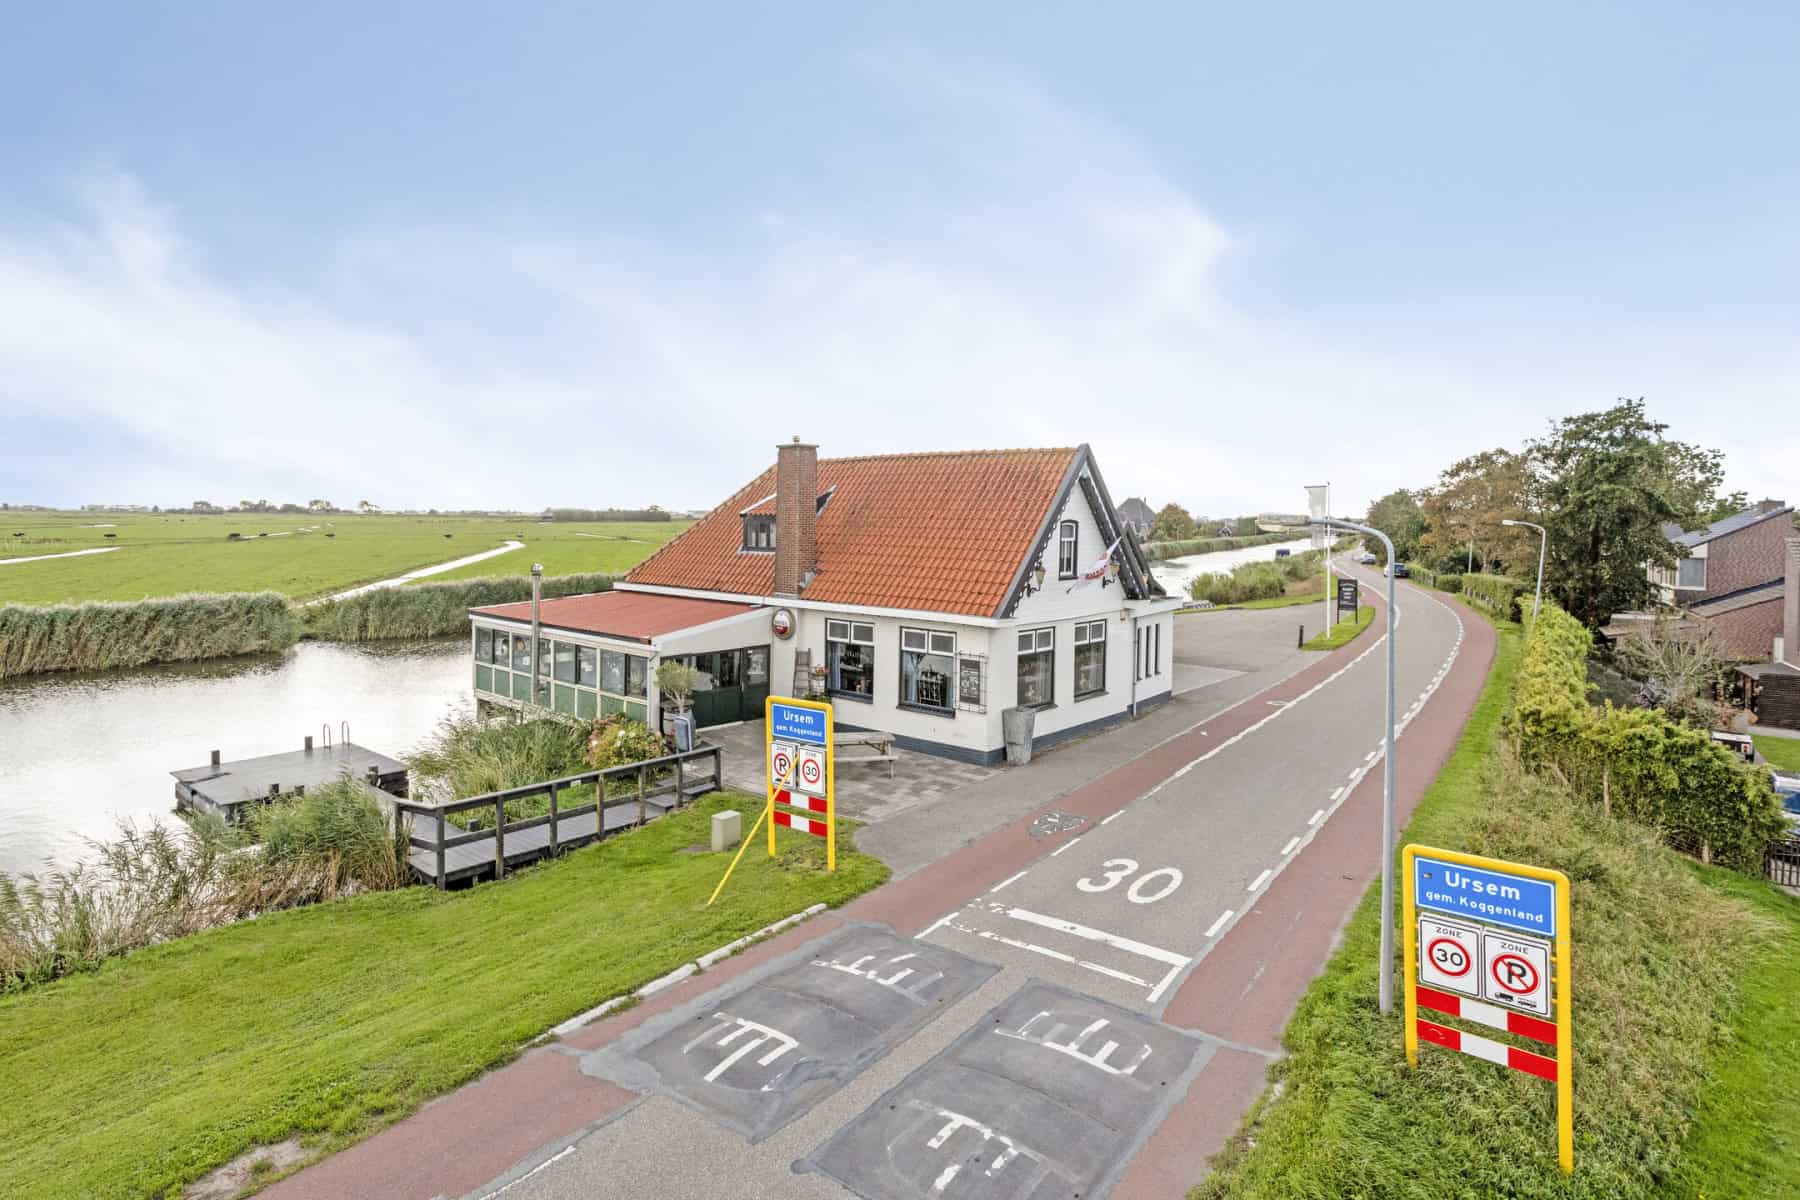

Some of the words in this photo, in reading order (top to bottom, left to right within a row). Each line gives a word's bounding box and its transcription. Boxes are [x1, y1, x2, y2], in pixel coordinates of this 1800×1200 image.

[783, 709, 814, 724] Ursem
[806, 765, 817, 777] 30
[1076, 858, 1183, 904] 30
[1444, 870, 1521, 900] Ursem
[1425, 890, 1456, 905] gem.
[1459, 896, 1544, 923] Koggenland
[1435, 926, 1464, 939] ZONE
[1500, 942, 1529, 955] ZONE
[1436, 948, 1463, 967] 30
